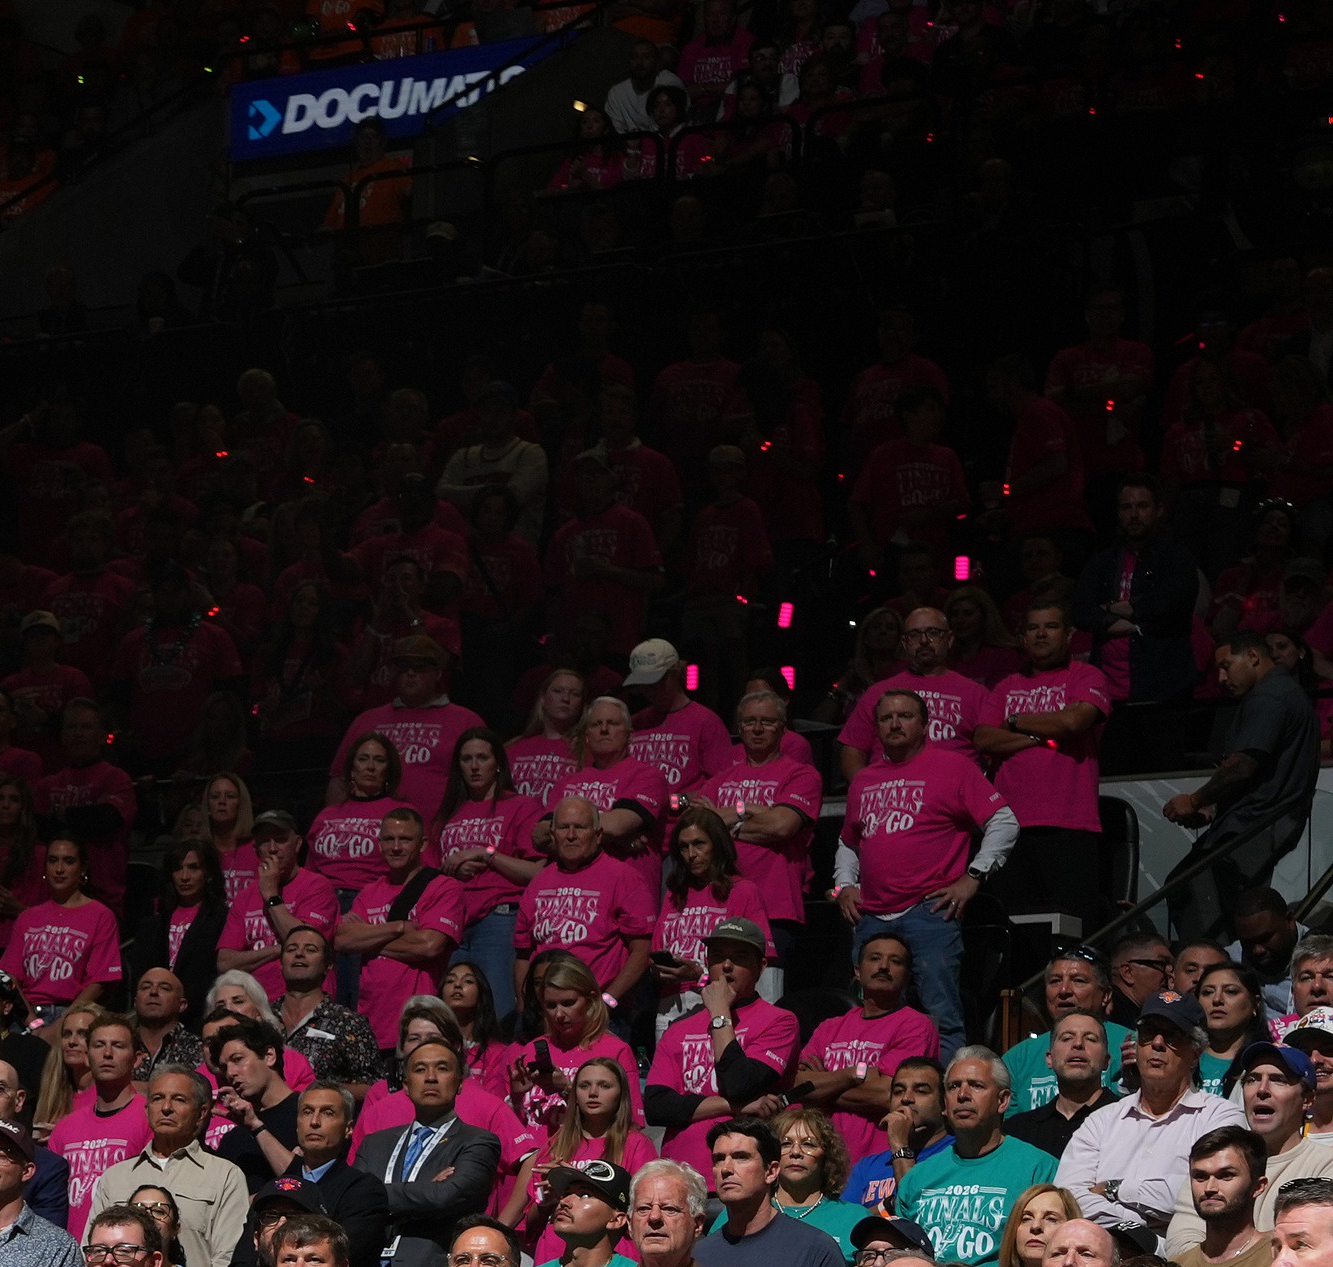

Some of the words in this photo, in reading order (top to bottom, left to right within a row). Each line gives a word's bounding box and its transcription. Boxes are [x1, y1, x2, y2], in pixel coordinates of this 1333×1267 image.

[282, 65, 526, 134] DOCUMAT
[929, 720, 956, 741] GO
[860, 786, 925, 815] FINALS
[885, 811, 914, 834] GO
[349, 833, 375, 857] GO
[557, 887, 581, 897] 2026
[535, 897, 599, 924] FINALS
[682, 906, 708, 916] 2026
[561, 919, 588, 943] GO
[23, 931, 86, 962] FINALS
[49, 957, 73, 980] GO
[682, 1040, 714, 1068] FIN
[1202, 1078, 1221, 1088] 20
[82, 1139, 108, 1149] 2026
[945, 1185, 980, 1195] 2026
[915, 1195, 1007, 1233] FINALS
[957, 1230, 994, 1260] GO
